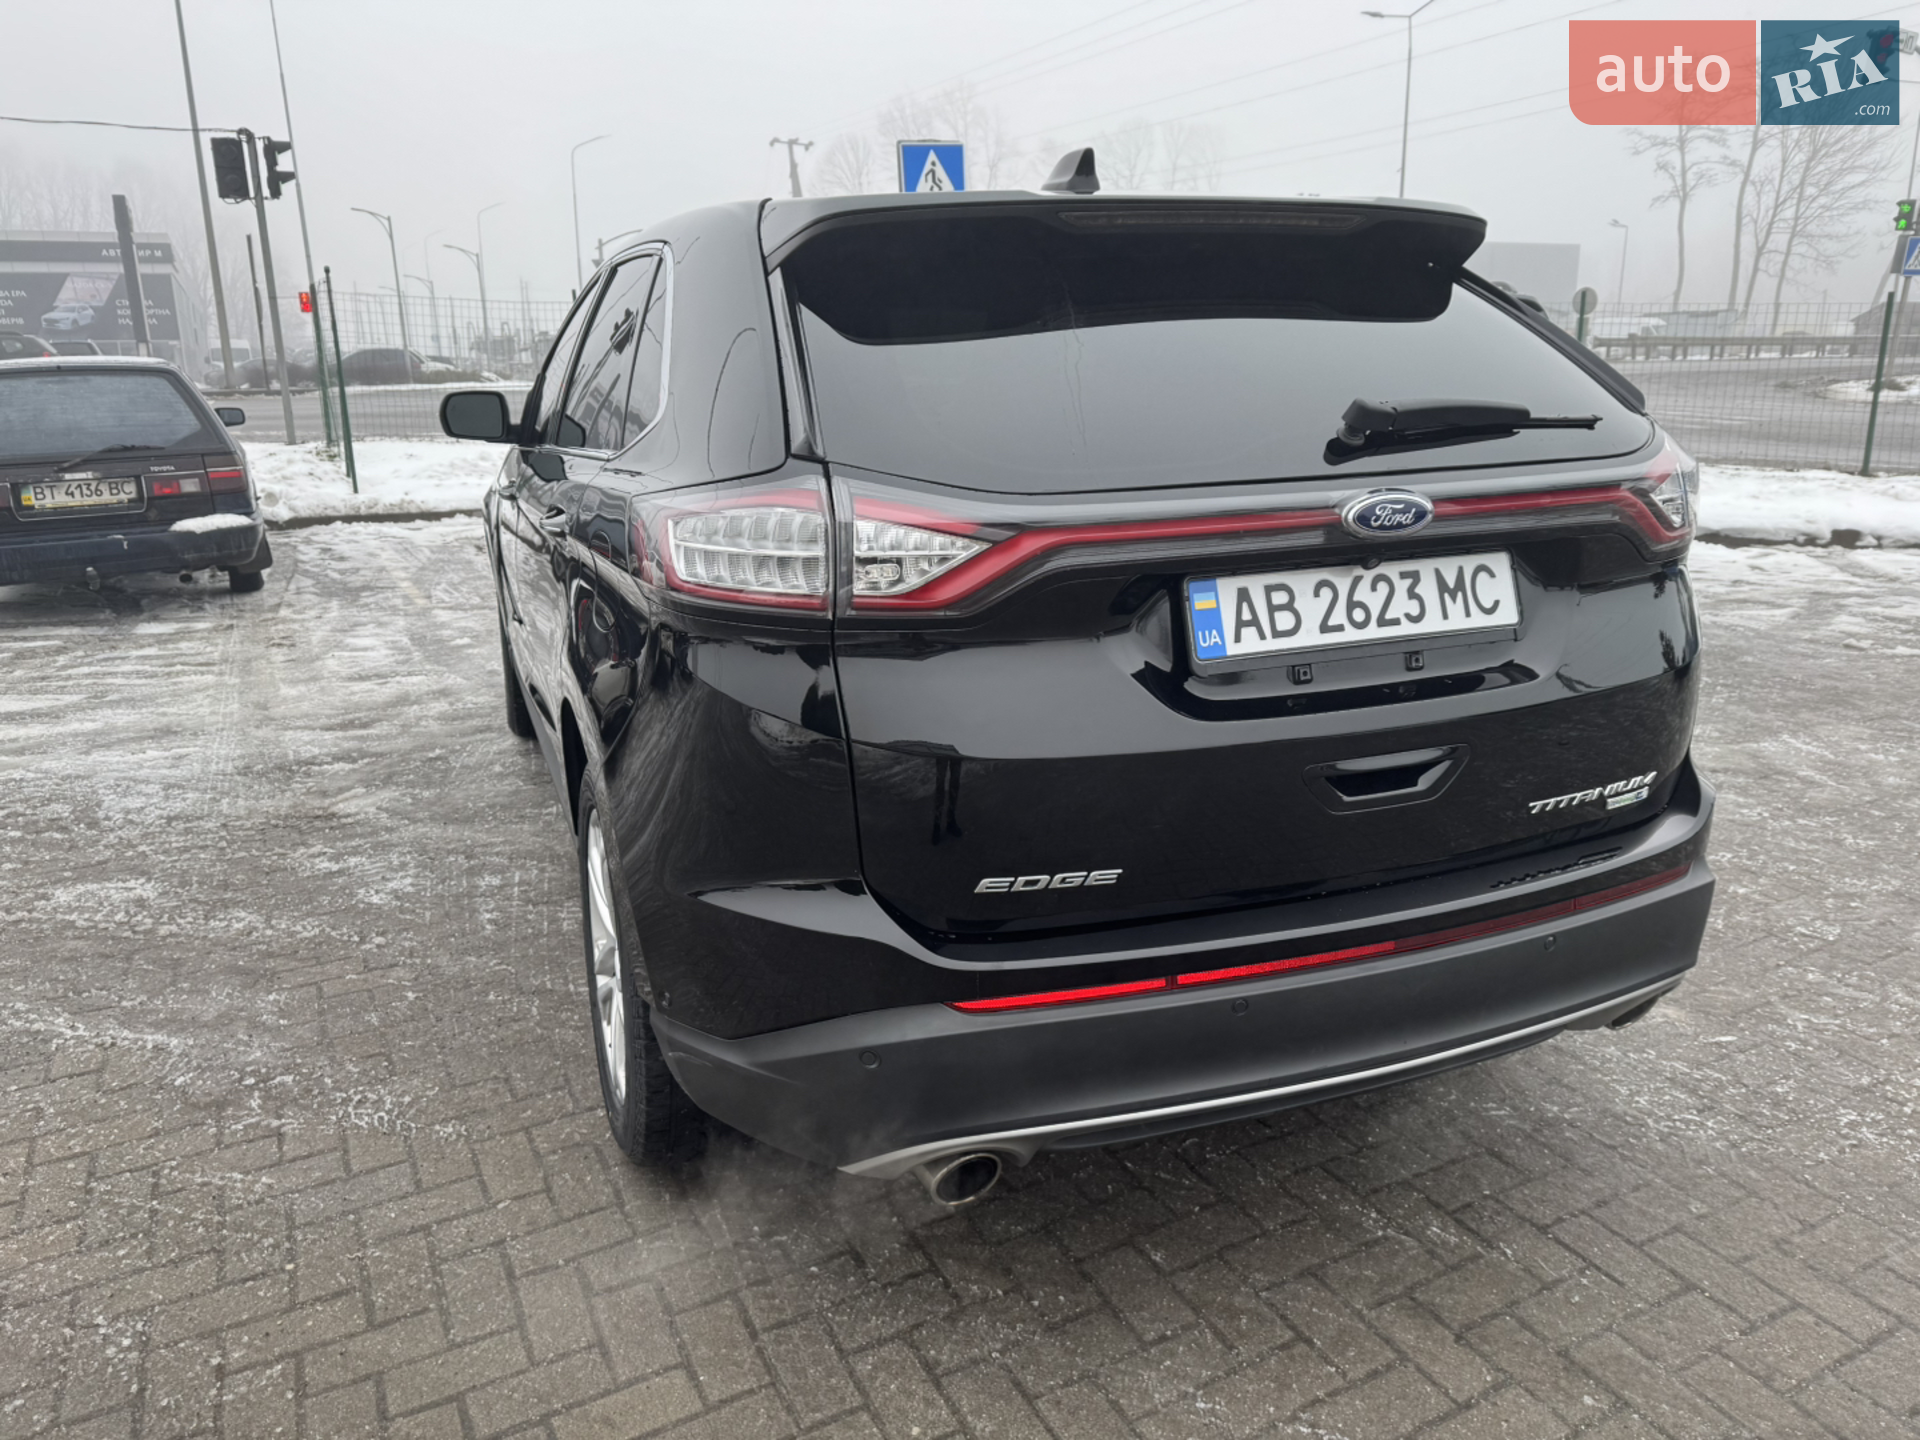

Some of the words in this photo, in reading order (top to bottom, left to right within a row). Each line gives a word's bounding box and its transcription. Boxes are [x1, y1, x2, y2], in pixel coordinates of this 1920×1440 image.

[148, 464, 176, 472] TOYOTA
[32, 485, 57, 501] BT
[64, 482, 104, 499] 4136
[107, 481, 133, 496] BC
[1370, 503, 1417, 528] Ford
[1233, 582, 1303, 644] AB
[1313, 569, 1427, 635] 2623
[1434, 563, 1501, 621] MC
[1198, 630, 1222, 648] UA
[1528, 770, 1658, 815] TITANIUM
[973, 868, 1124, 894] EDGE
